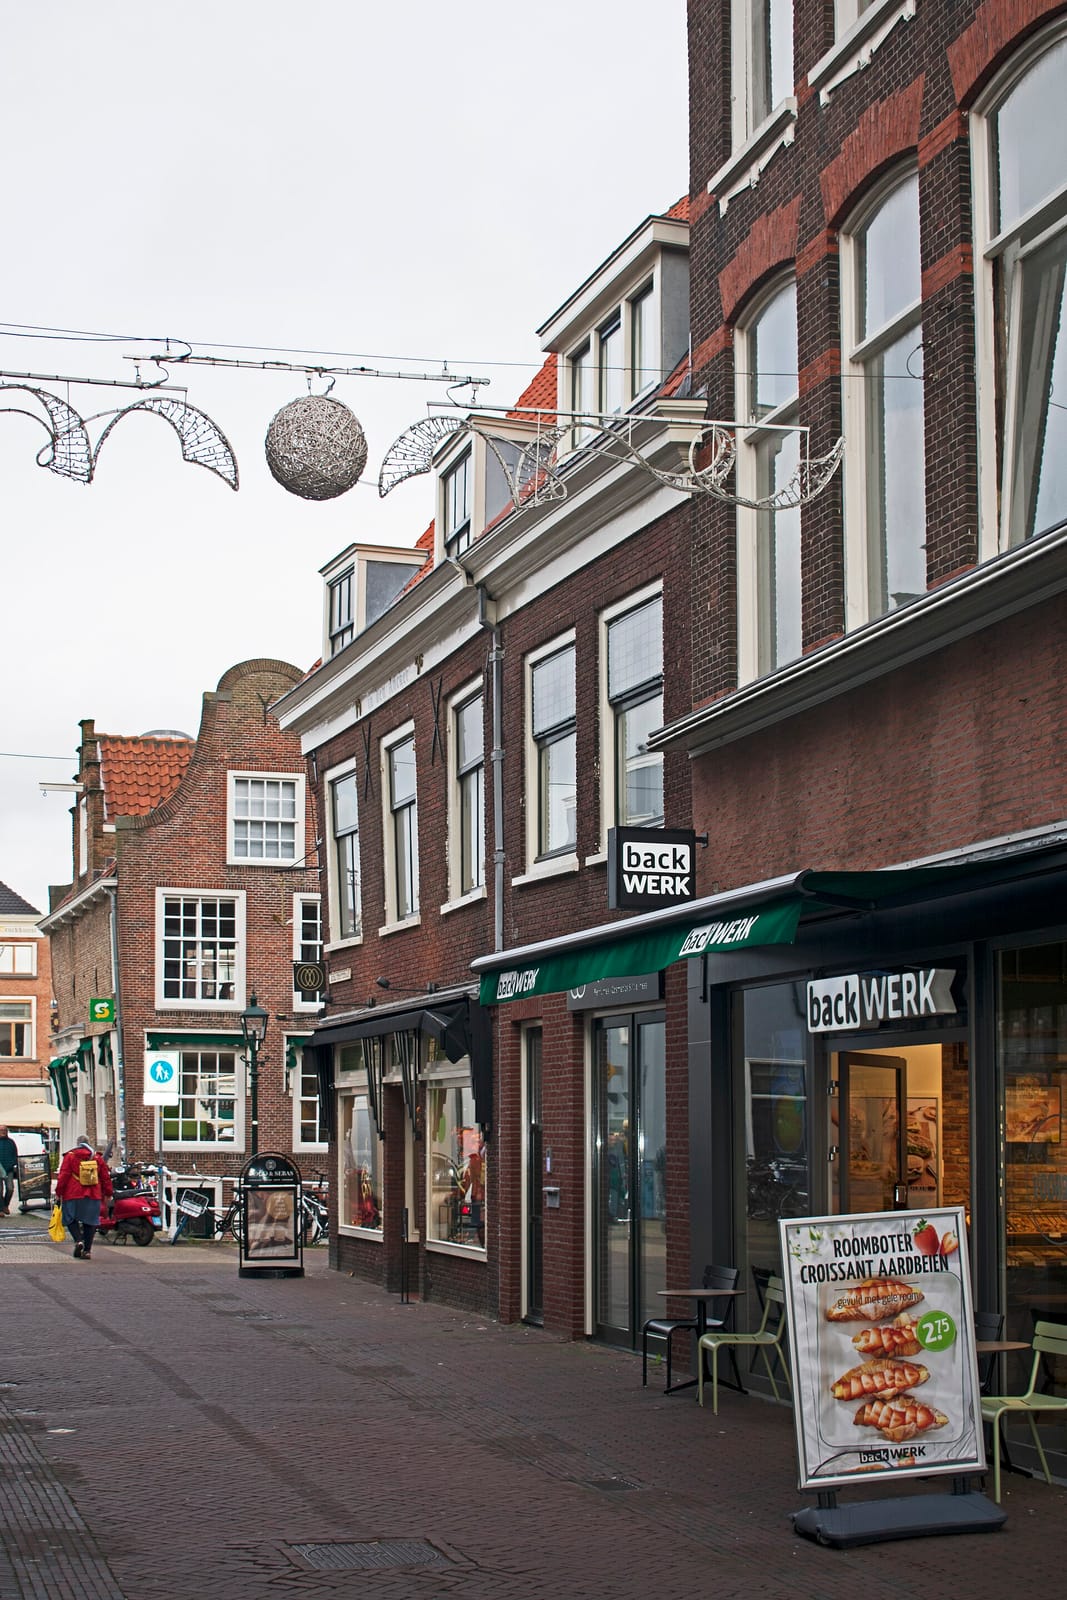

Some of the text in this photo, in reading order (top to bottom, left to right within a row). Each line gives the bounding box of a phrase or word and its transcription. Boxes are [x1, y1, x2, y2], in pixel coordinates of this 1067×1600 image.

[627, 845, 686, 870] back
[623, 874, 691, 896] WERK
[833, 1233, 913, 1258] ROOMBOTER
[800, 1253, 949, 1284] CROISSANT AARDBEIEN
[837, 1292, 919, 1309] gevuld met gele room
